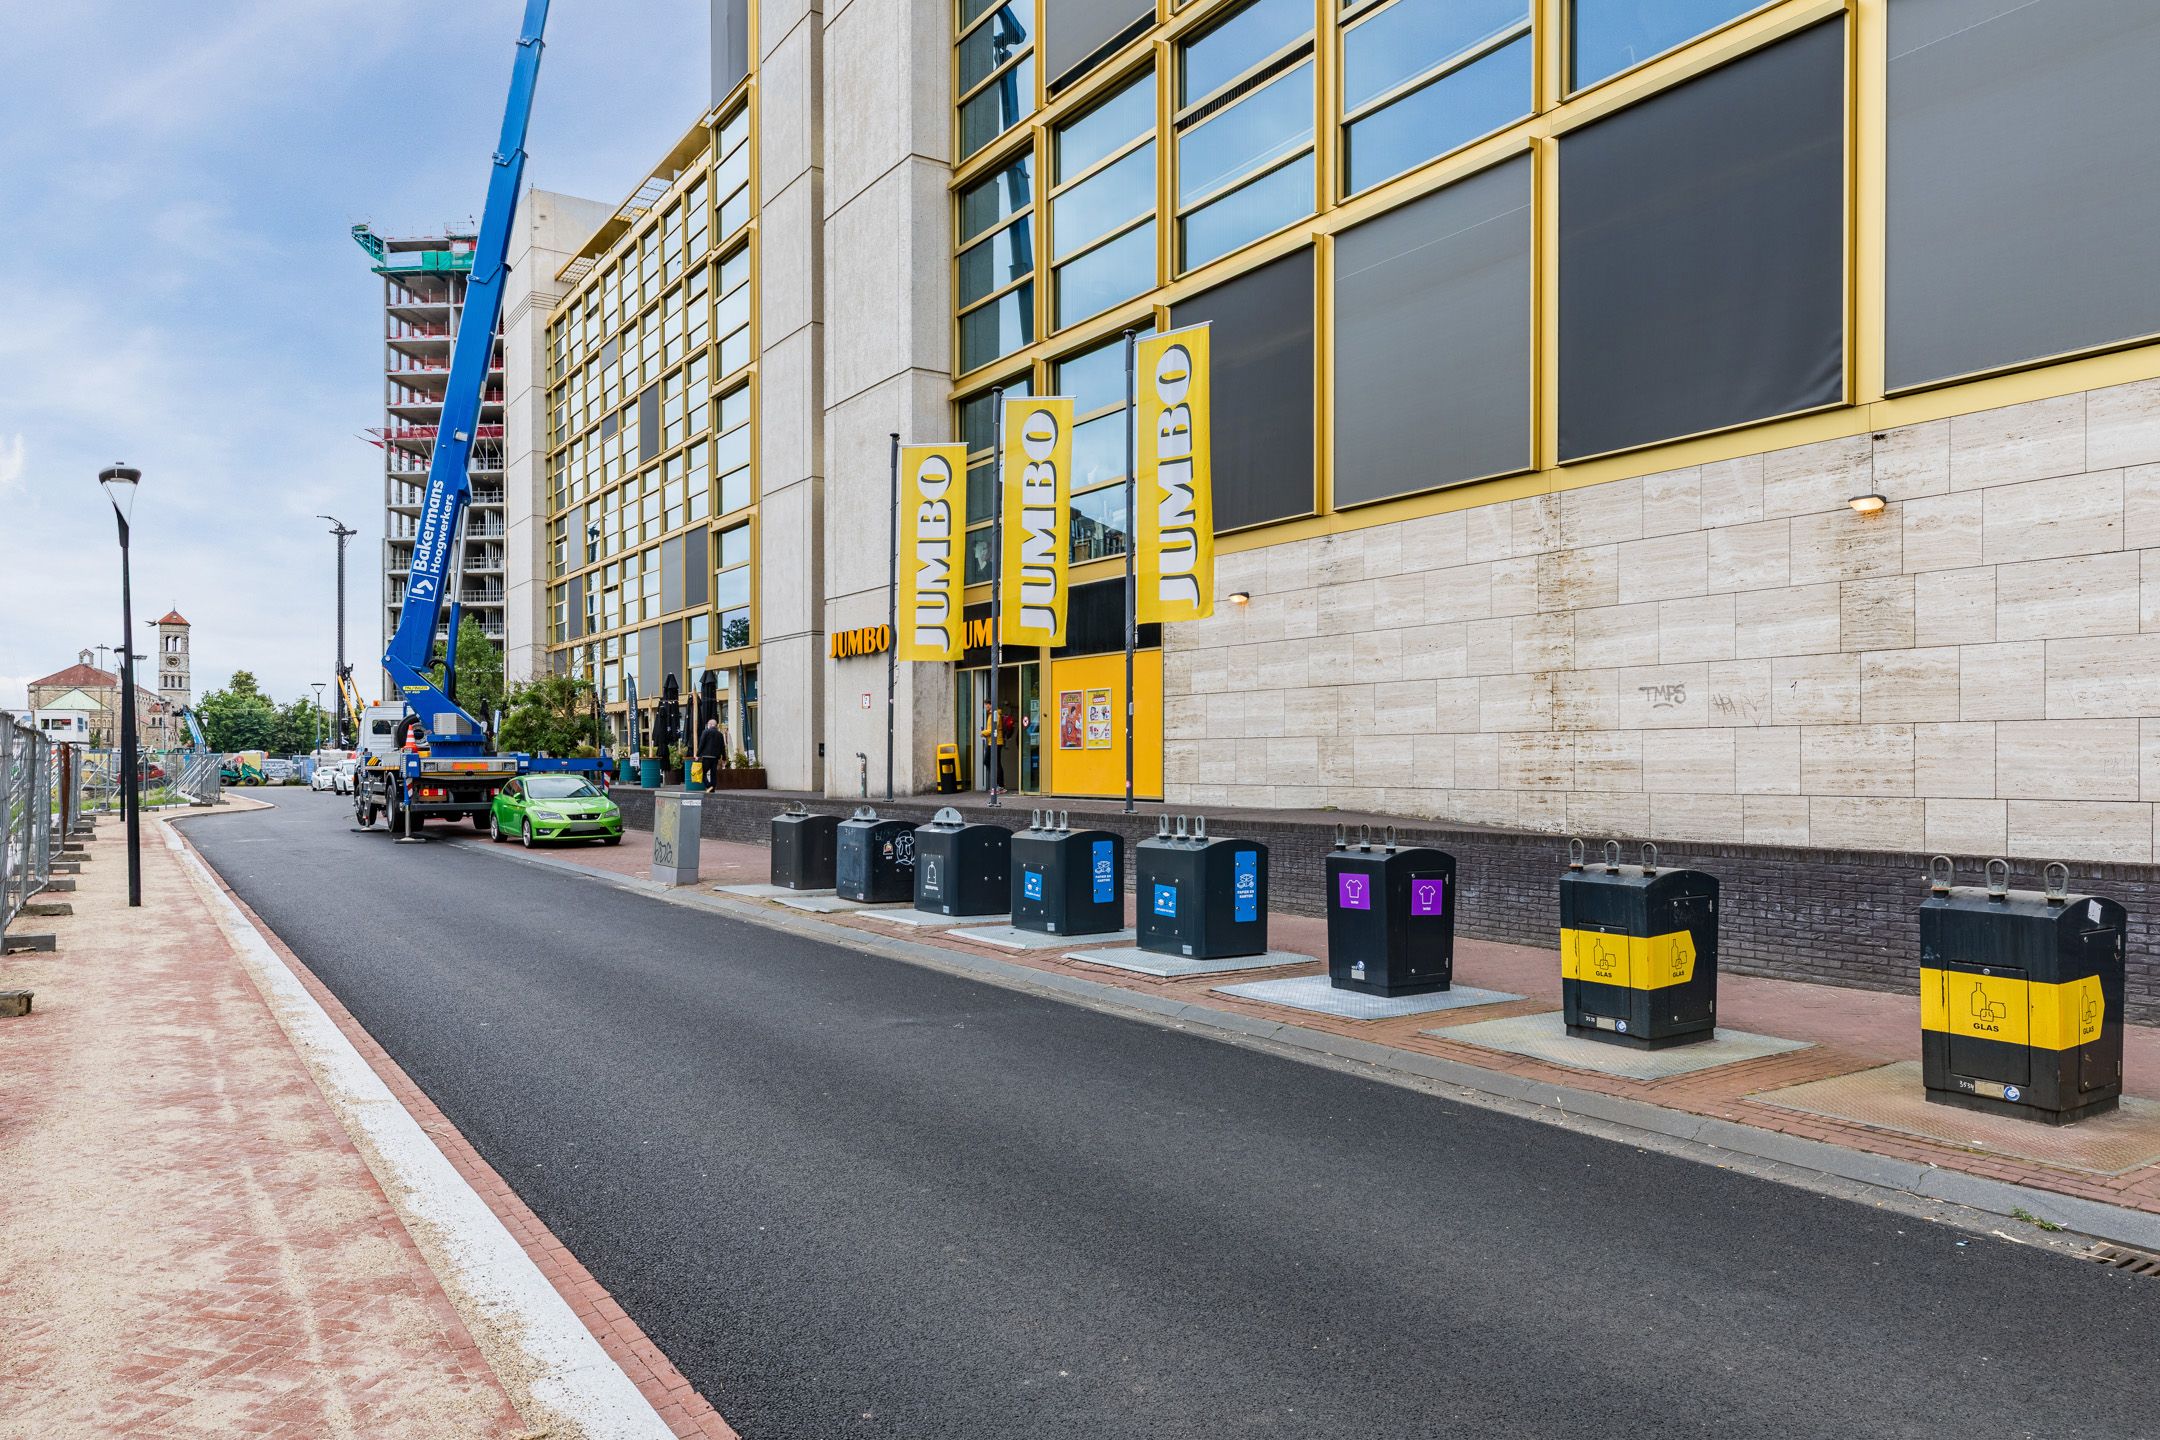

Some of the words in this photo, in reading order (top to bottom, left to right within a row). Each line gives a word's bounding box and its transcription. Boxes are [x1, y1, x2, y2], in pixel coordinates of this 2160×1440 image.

[1156, 344, 1200, 609] JUMBO
[413, 480, 444, 572] Bakermans
[429, 494, 454, 573] Hoogwerkers
[1020, 409, 1059, 638] JUMBO
[915, 454, 953, 653] JUMBO
[829, 624, 890, 659] JUMBO
[1595, 970, 1612, 978] GLAS
[1672, 970, 1685, 978] GLAS
[1973, 1022, 1999, 1032] GLAS
[2083, 1025, 2095, 1035] GLAS
